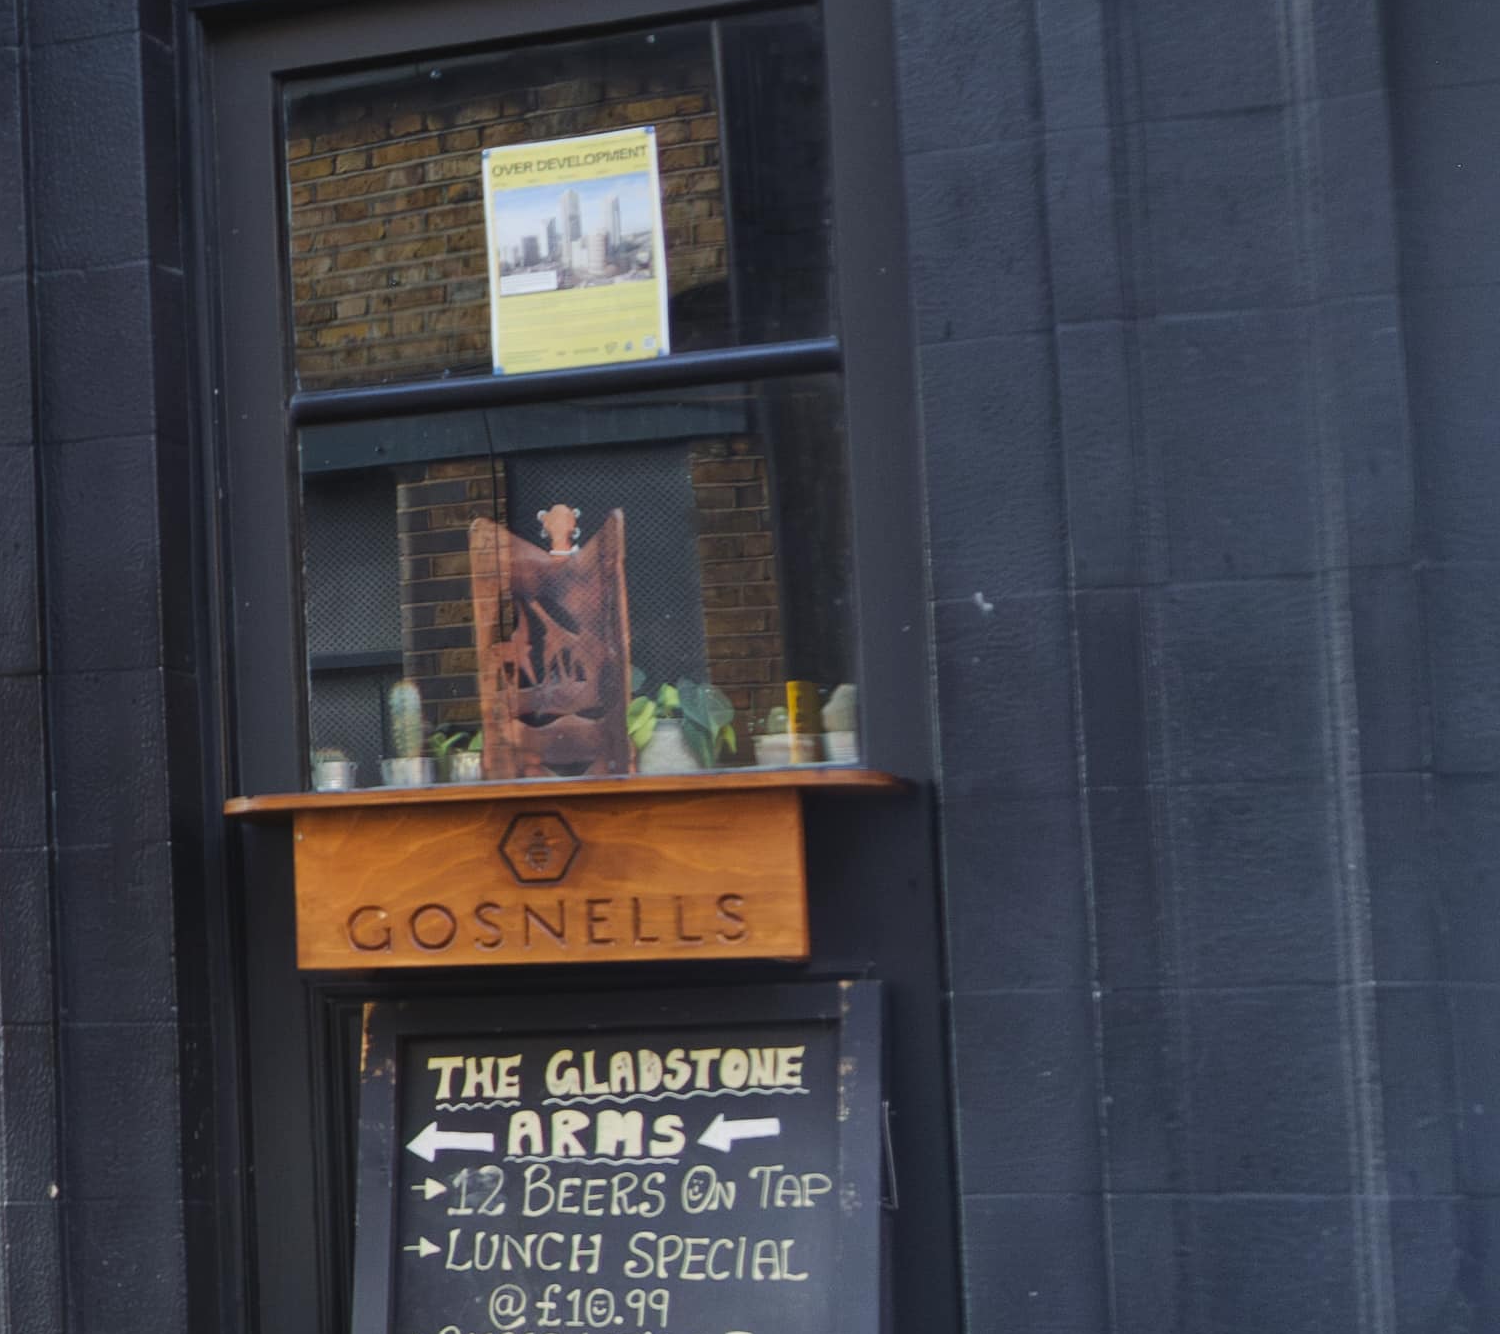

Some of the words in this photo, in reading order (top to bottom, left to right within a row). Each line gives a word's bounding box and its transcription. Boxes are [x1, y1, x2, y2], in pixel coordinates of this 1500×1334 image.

[491, 160, 534, 178] OVER
[536, 145, 648, 172] DEVELOPMENT
[347, 892, 751, 954] GOSNELLS
[428, 1054, 522, 1101] THE
[545, 1046, 805, 1097] GLADSTONE
[507, 1109, 687, 1158] ARMS
[446, 1165, 506, 1216] 12
[522, 1164, 667, 1217] BEERS
[749, 1165, 833, 1210] TAP
[445, 1228, 603, 1273] LUNCH
[623, 1231, 809, 1280] SPECIAL
[488, 1284, 527, 1330] @
[536, 1284, 671, 1328] £10.99
